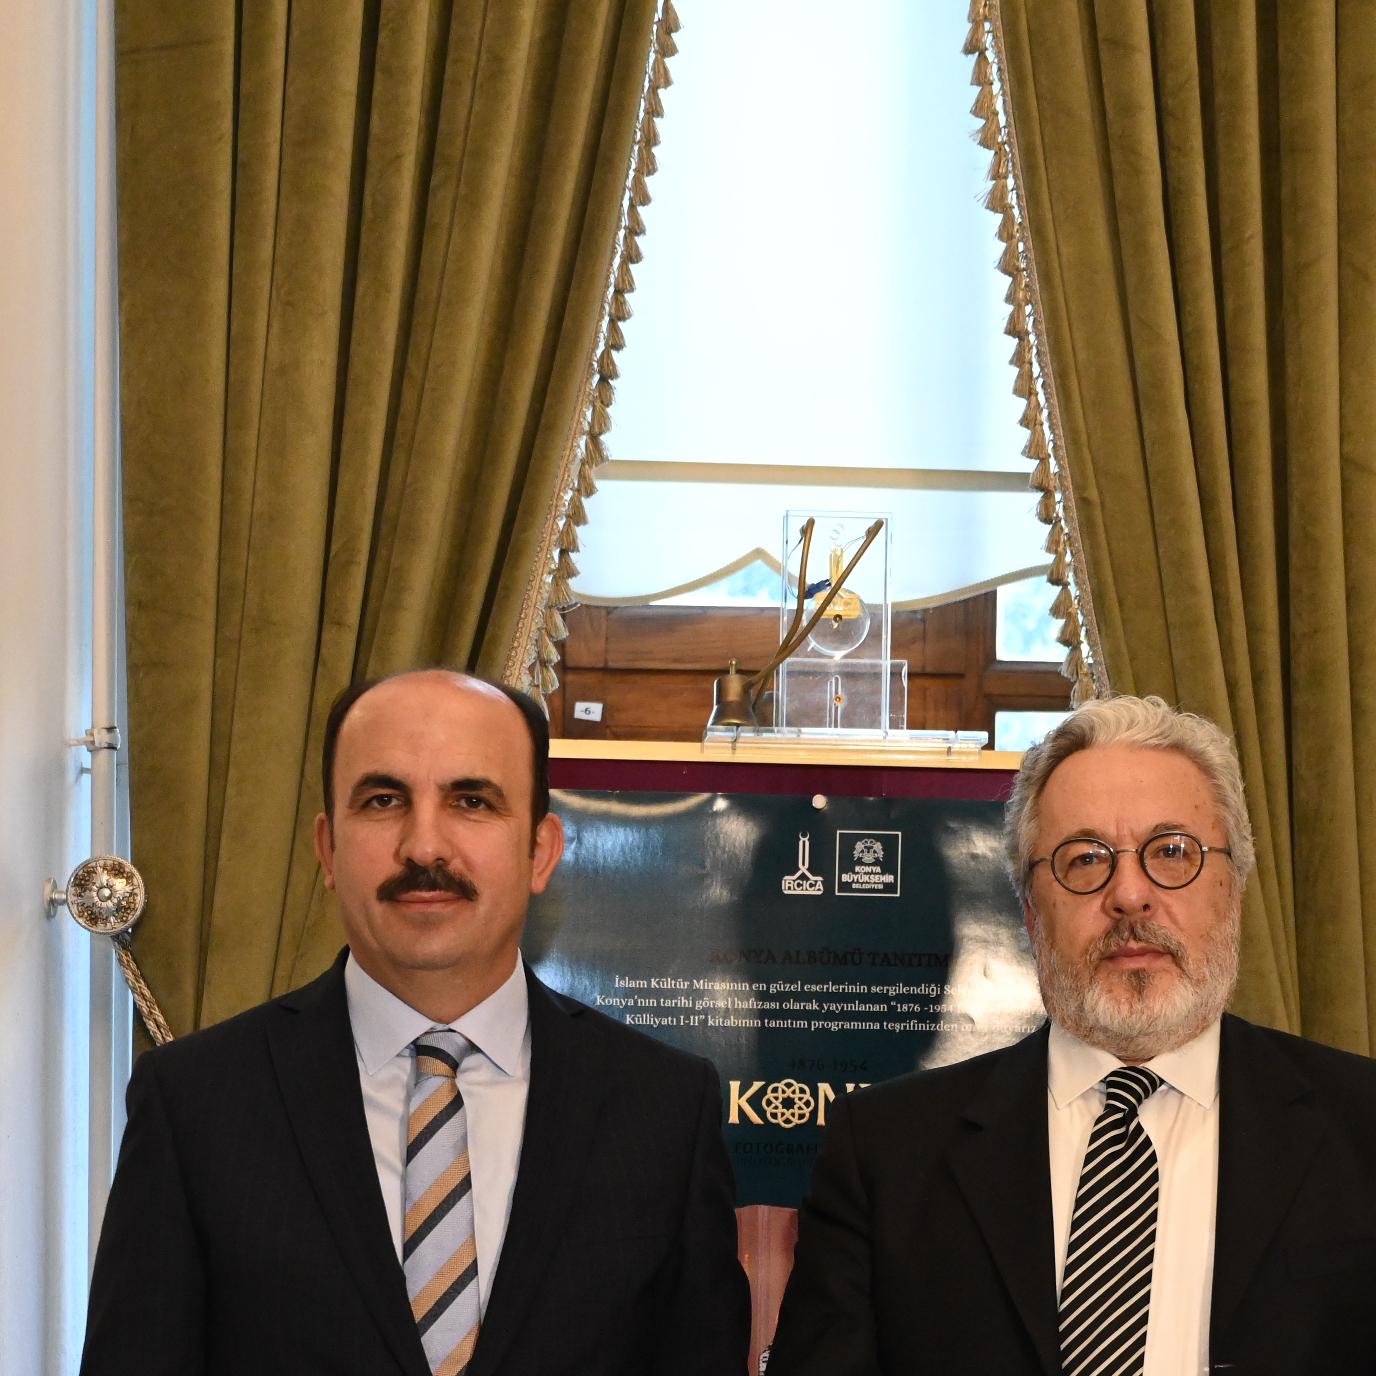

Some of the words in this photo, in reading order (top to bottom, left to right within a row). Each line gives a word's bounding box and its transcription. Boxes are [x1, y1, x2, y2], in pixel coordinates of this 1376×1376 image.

[841, 872, 894, 883] BÜYÜKŞEHİR
[855, 865, 881, 873] KONYA
[782, 880, 824, 891] IRCICA
[782, 948, 863, 965] ALBÜMÜ
[615, 975, 647, 989] İslam
[651, 978, 690, 990] Kültür
[693, 979, 749, 992] Mirasının
[752, 984, 767, 992] en
[769, 981, 801, 994] güzel
[804, 981, 868, 994] eserlerinin
[870, 982, 942, 998] sergilendiği
[660, 997, 693, 1008] tarihi
[695, 998, 732, 1011] görsel
[734, 997, 780, 1010] hafızası
[782, 999, 819, 1010] olarak
[822, 1001, 888, 1014] yayınlanan
[626, 1014, 676, 1028] Külliyatı
[708, 1015, 761, 1028] kitabının
[764, 1017, 808, 1029] tanıtım
[811, 1019, 880, 1033] programına
[883, 1020, 959, 1033] teşrifinizden
